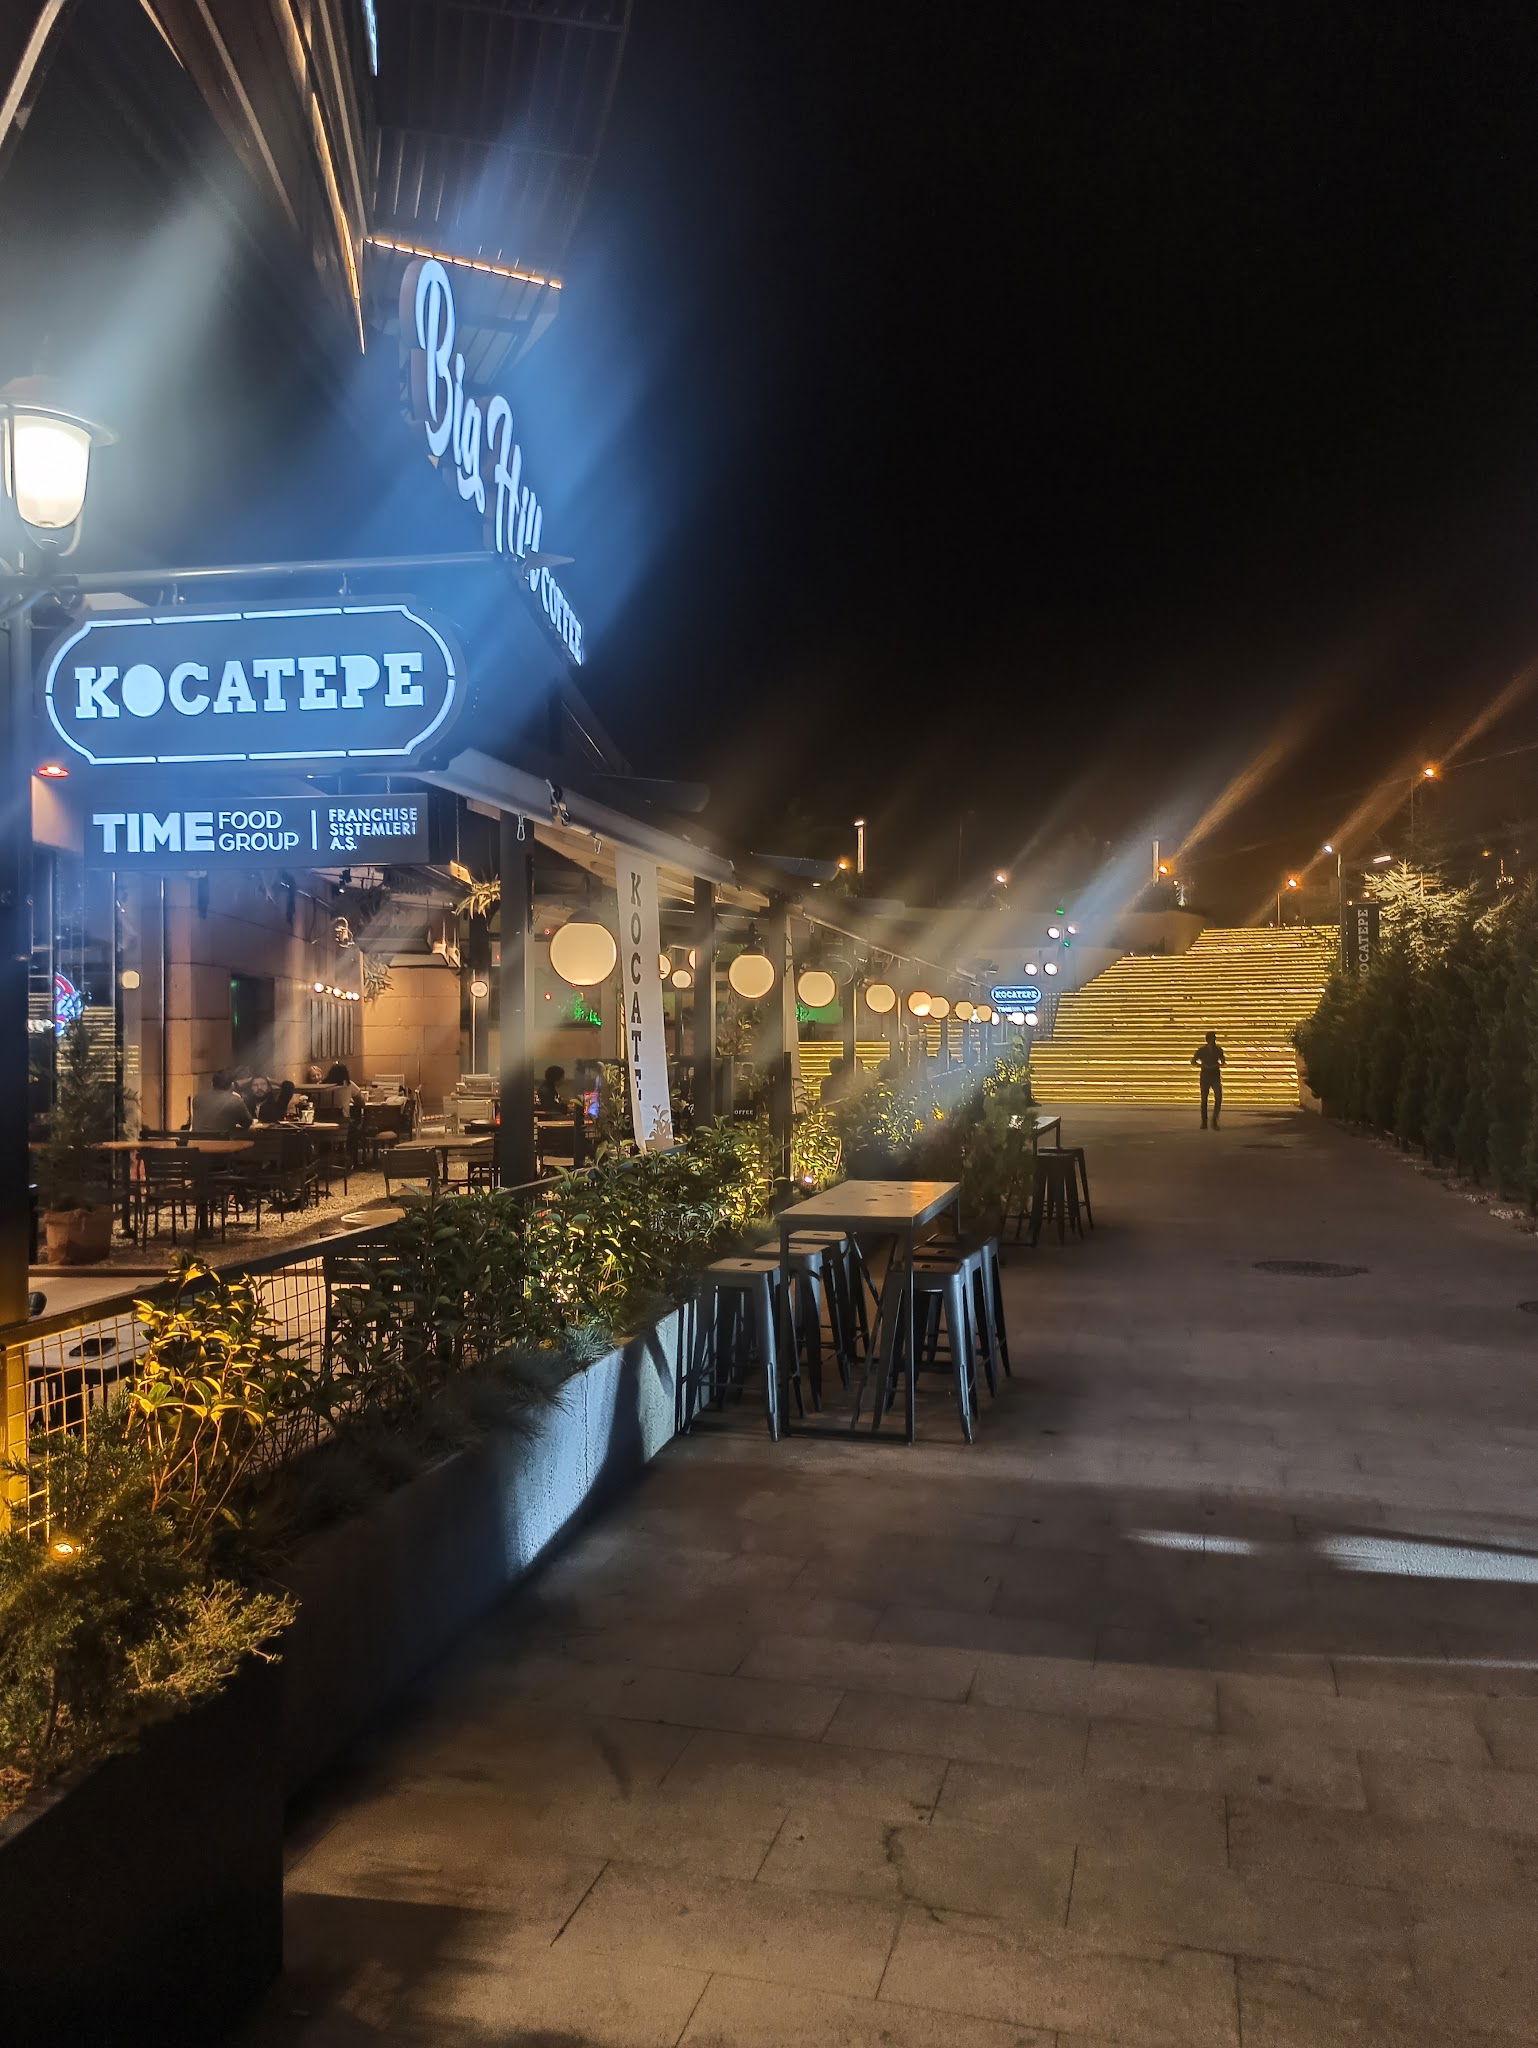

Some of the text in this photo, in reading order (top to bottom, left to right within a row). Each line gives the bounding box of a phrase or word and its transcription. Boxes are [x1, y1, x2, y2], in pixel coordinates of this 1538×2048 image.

[415, 260, 485, 514] Big
[75, 652, 424, 719] KOCATEPE
[218, 811, 282, 830] FOOD
[328, 807, 418, 823] FRANCHISE
[92, 812, 215, 853] TIME
[218, 832, 300, 851] GROUP
